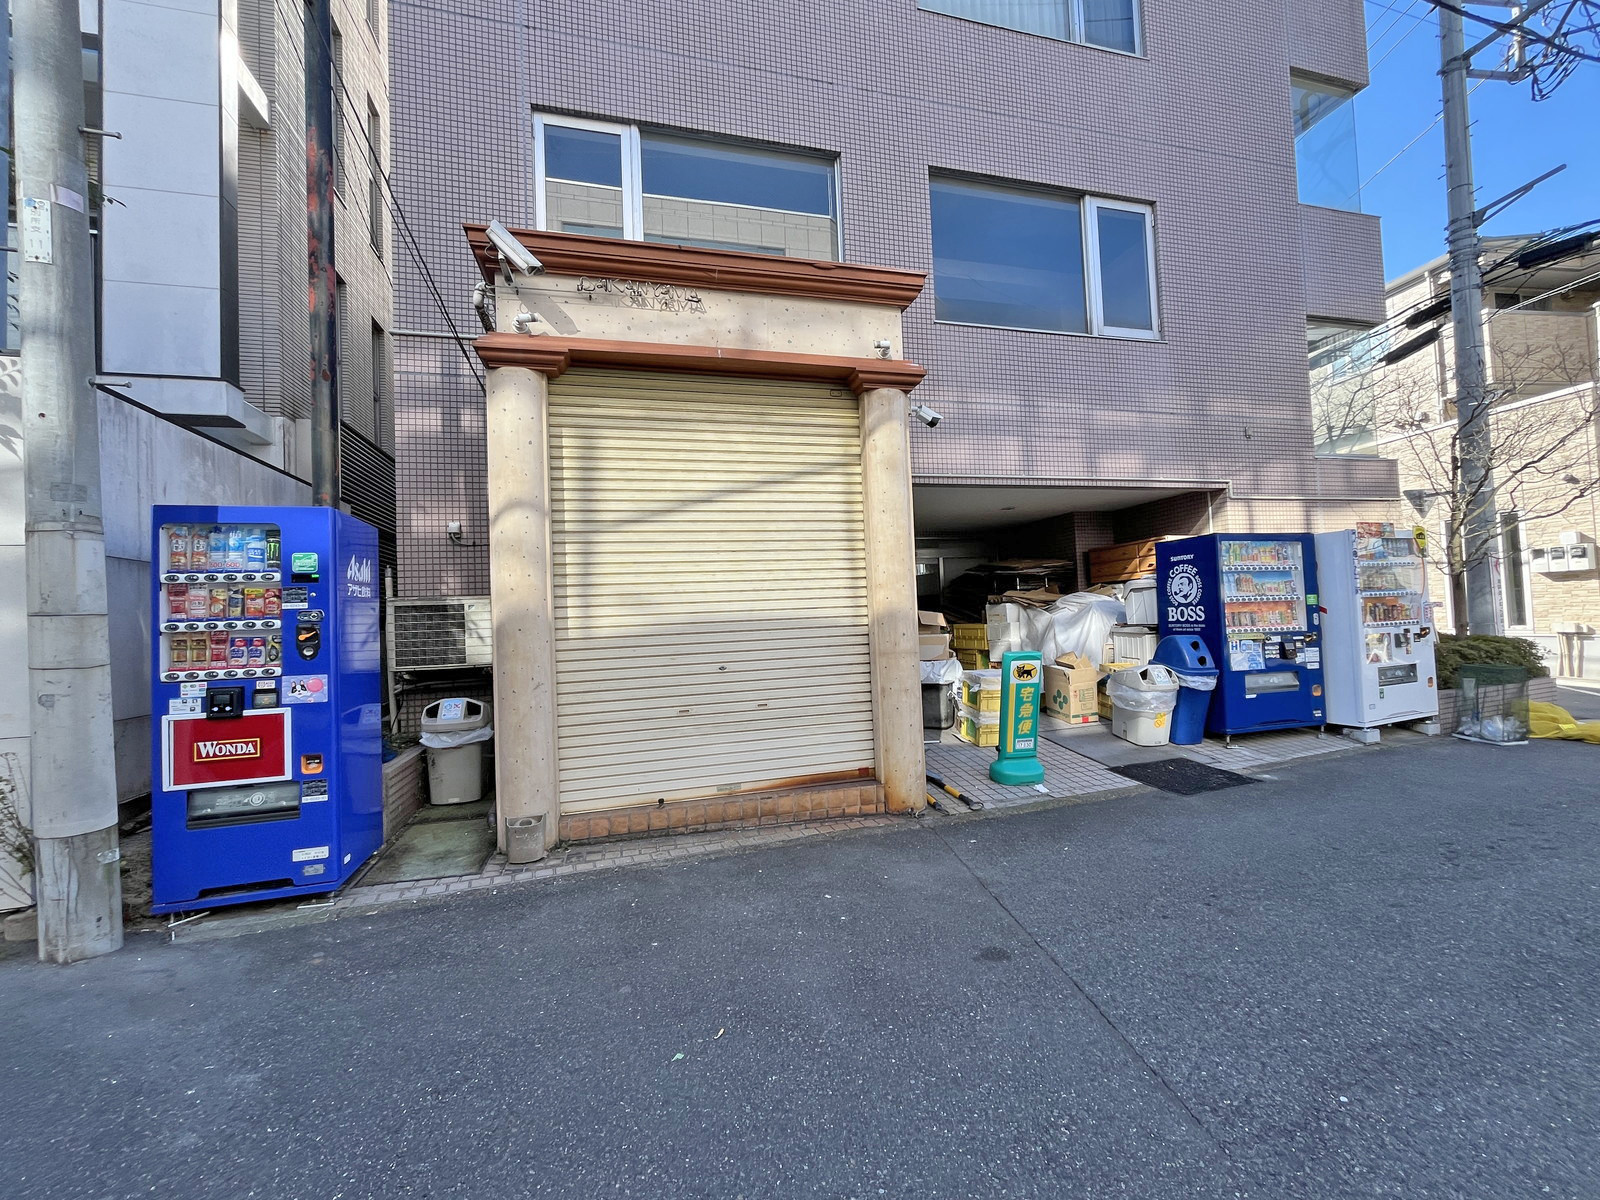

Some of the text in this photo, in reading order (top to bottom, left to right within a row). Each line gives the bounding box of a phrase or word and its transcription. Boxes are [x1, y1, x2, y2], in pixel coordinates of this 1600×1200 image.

[1170, 554, 1194, 562] SUNTORY
[347, 554, 371, 583] Asahi
[1169, 564, 1198, 577] COFFEE
[347, 583, 371, 598] アサヒ飲料
[1168, 606, 1206, 622] BOSS
[1018, 686, 1035, 735] 宅急便
[197, 741, 256, 758] WONDA
